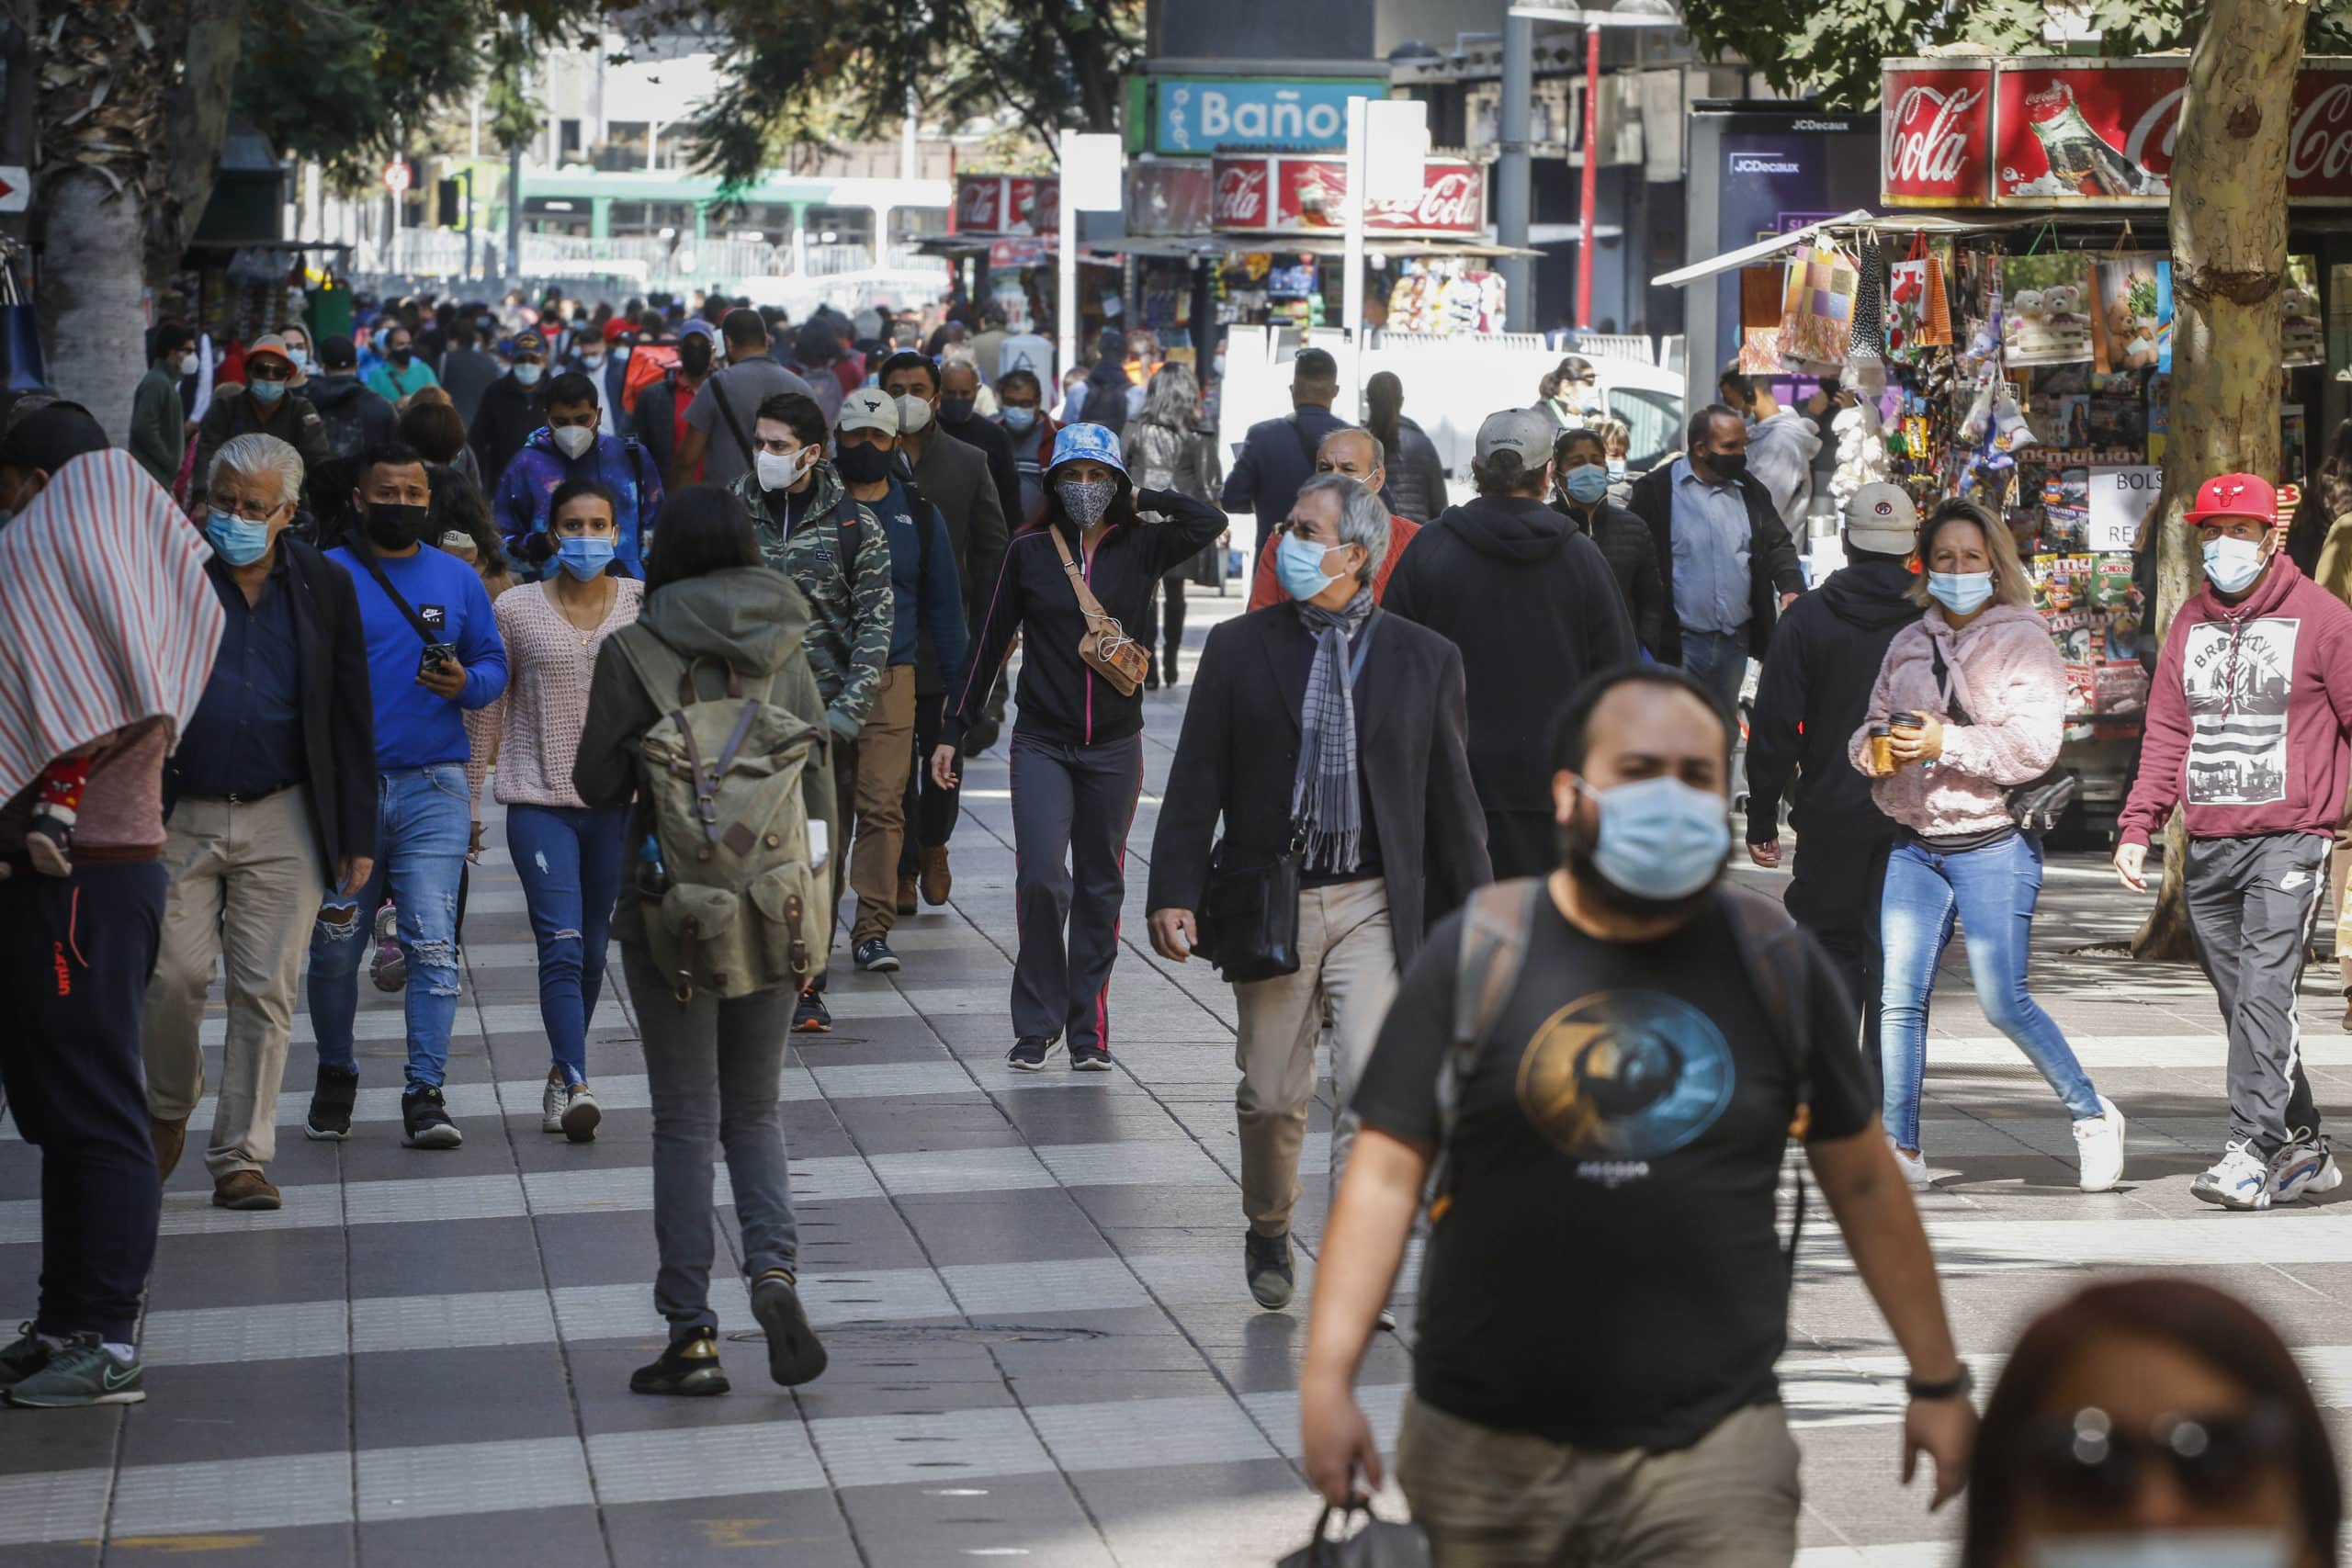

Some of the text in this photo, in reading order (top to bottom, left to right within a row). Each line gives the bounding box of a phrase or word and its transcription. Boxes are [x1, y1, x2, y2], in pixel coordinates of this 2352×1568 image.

[1201, 90, 1348, 138] Baño
[1792, 119, 1849, 130] JCDecaux
[1885, 85, 1985, 182] Cola
[1734, 160, 1800, 173] JCDecaux
